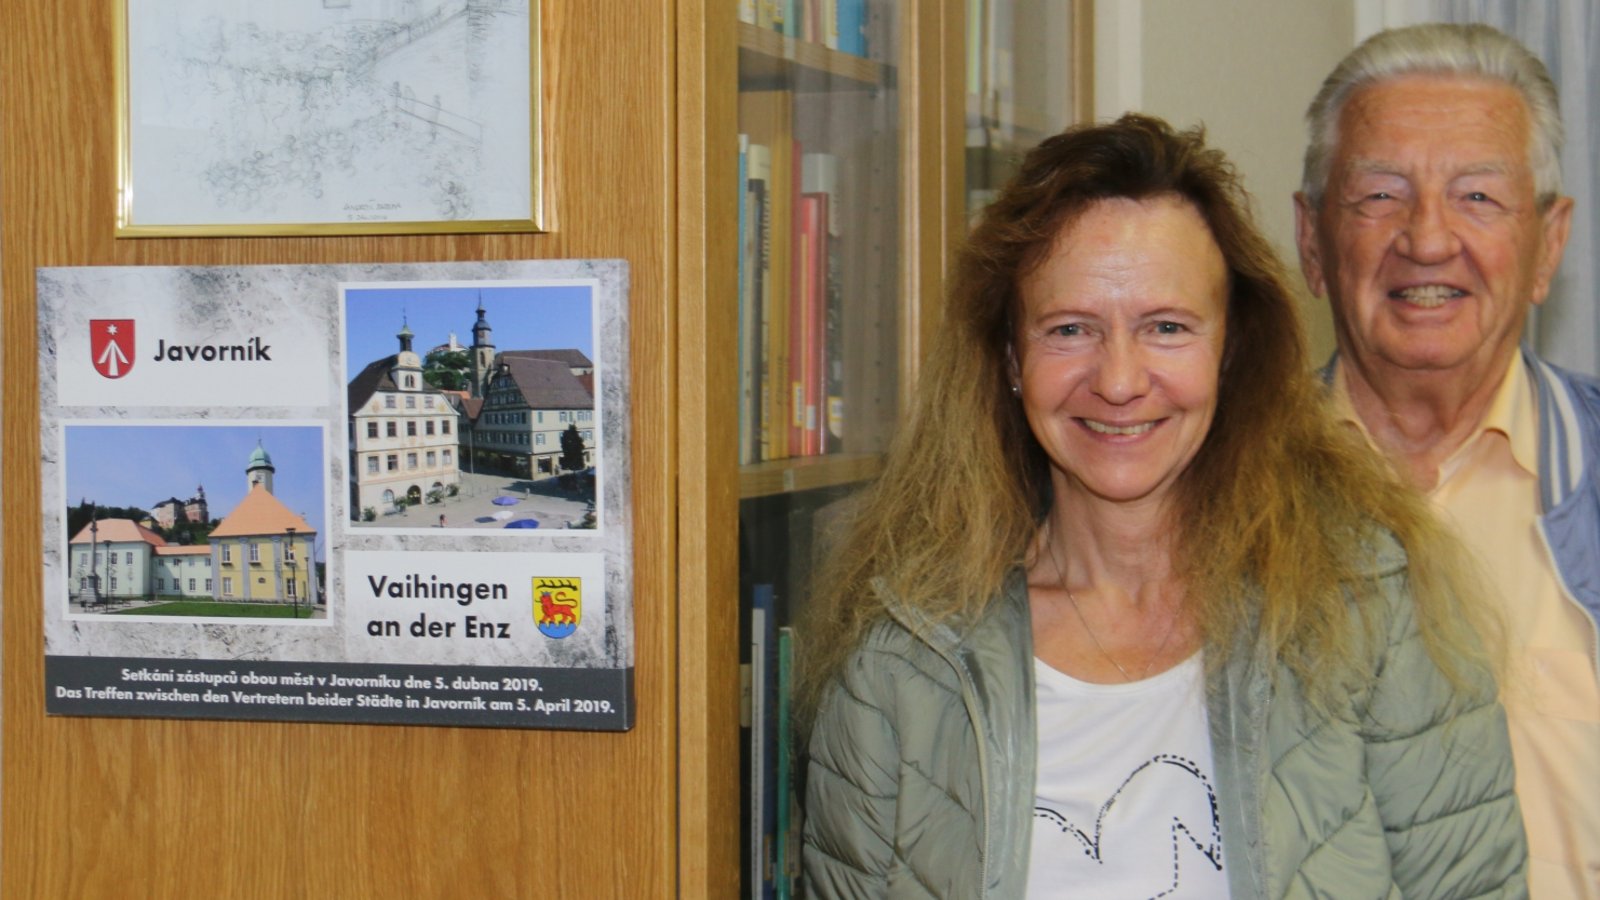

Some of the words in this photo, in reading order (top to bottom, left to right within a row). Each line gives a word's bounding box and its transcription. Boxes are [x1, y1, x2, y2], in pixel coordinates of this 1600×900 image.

[153, 336, 272, 362] Javorník
[368, 574, 508, 606] Vaihingen
[367, 619, 400, 637] an
[410, 612, 456, 638] der
[465, 615, 511, 639] Enz
[121, 667, 174, 682] Setkání
[177, 668, 238, 687] zástupců
[241, 671, 278, 685] obou
[280, 672, 315, 687] měst
[316, 676, 326, 687] v
[329, 674, 401, 689] Javorníku
[404, 675, 432, 690] dne
[434, 676, 449, 690] 5.
[452, 676, 499, 691] dubna
[502, 677, 543, 692] 2019.
[55, 686, 82, 700] Das
[84, 686, 133, 701] Treffen
[136, 688, 200, 703] zwischen
[202, 689, 229, 704] den
[231, 690, 304, 706] Vertretern
[307, 692, 354, 708] beider
[356, 694, 403, 708] Städte
[406, 695, 419, 709] in
[423, 696, 487, 711] Javorník
[489, 700, 513, 712] am
[516, 699, 531, 712] 5.
[534, 699, 571, 715] April
[573, 700, 616, 714] 2019.
